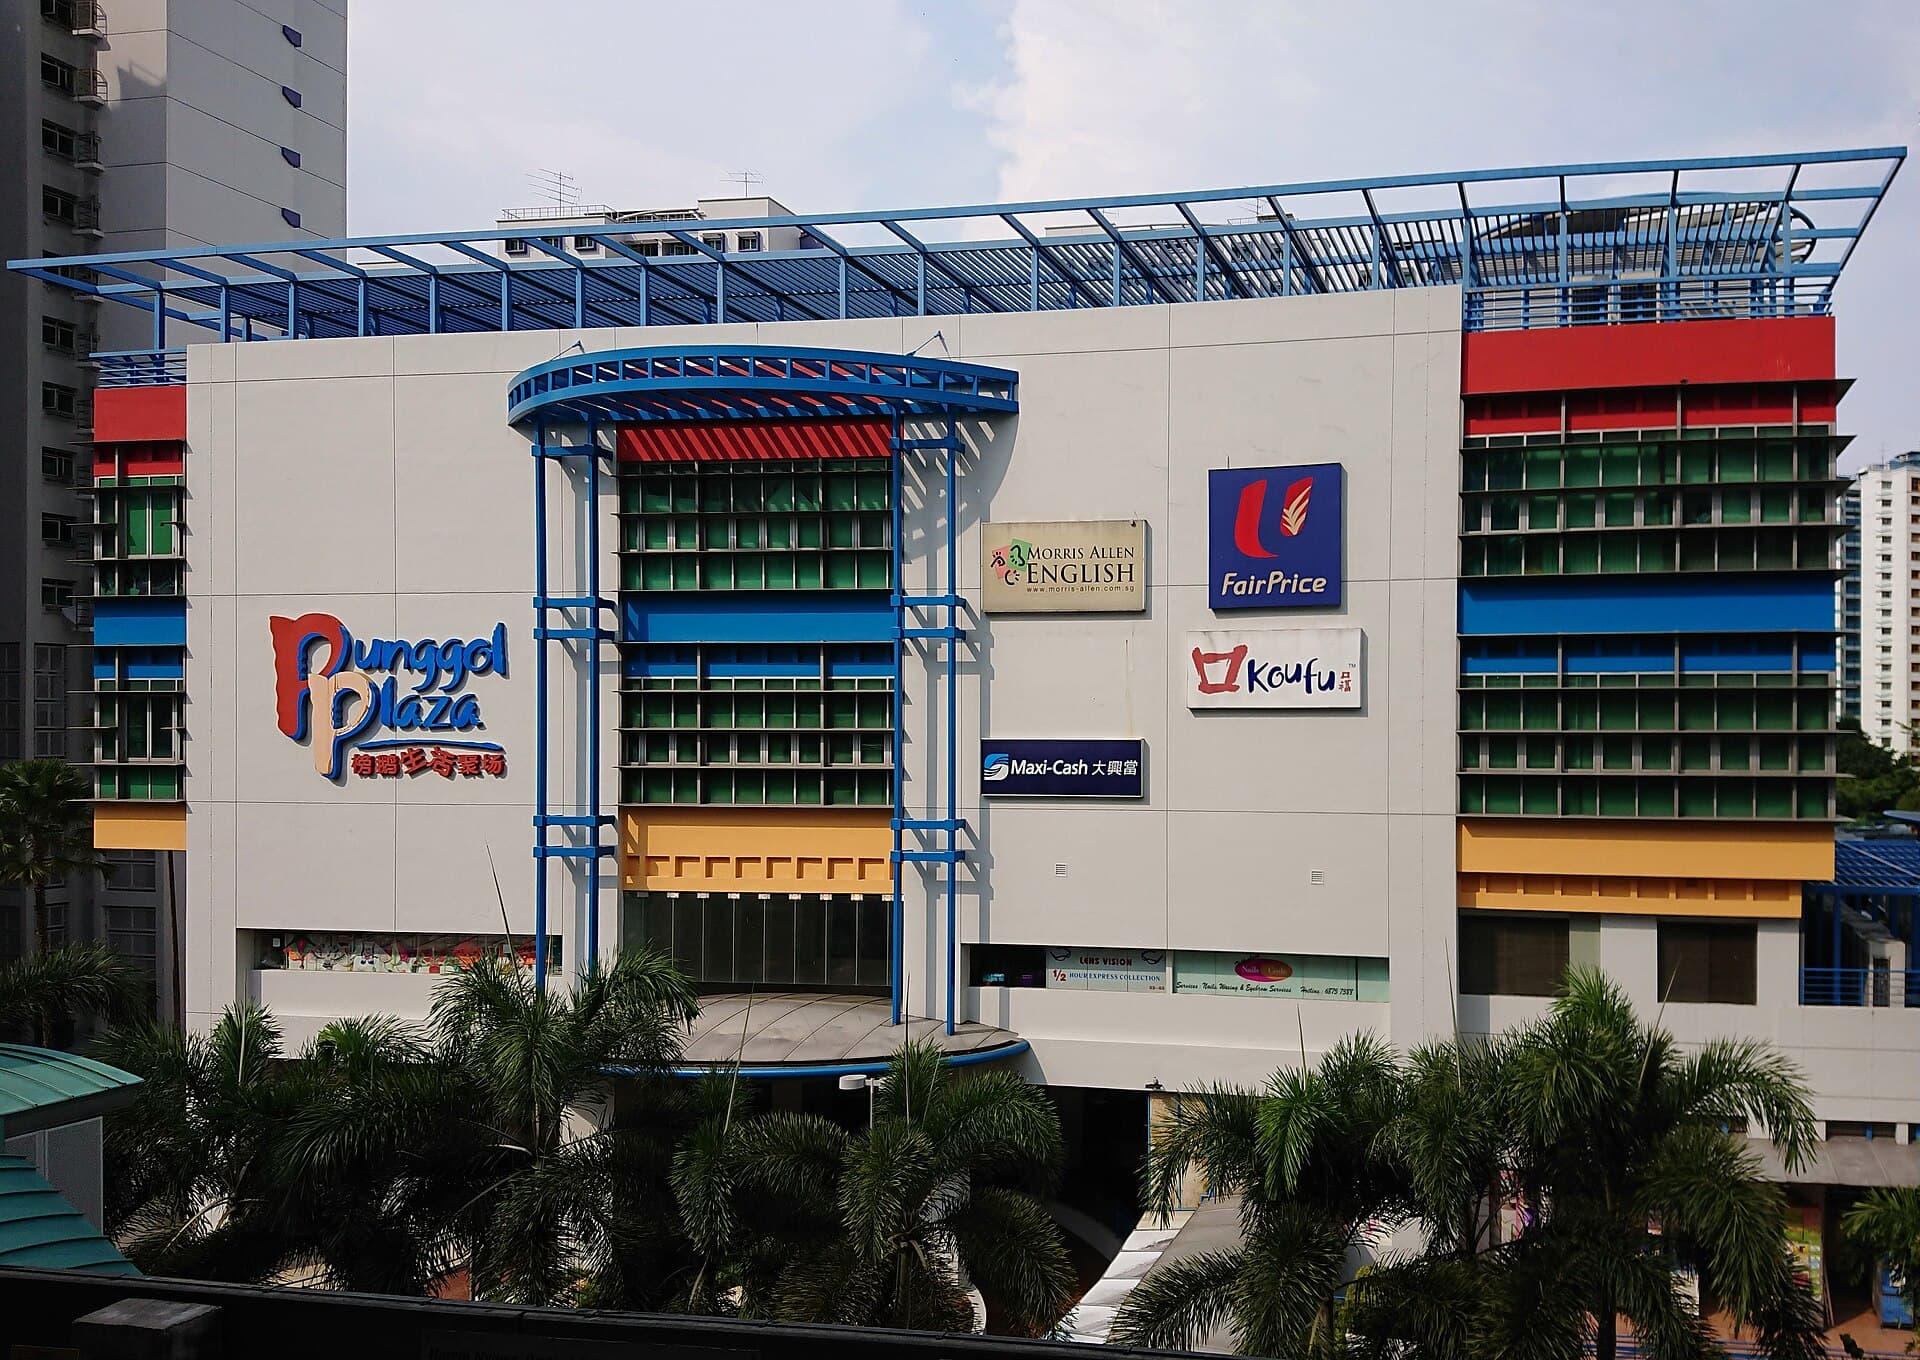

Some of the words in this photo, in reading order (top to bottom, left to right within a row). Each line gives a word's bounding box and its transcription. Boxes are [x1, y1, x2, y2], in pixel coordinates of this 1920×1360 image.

[1027, 547, 1084, 560] MORRIS
[1090, 545, 1134, 559] ALLEN
[1027, 563, 1135, 584] ENGLISH
[1027, 585, 1135, 593] www.morris-allen.com.sg
[1222, 570, 1327, 595] FairPrice
[269, 613, 507, 742] Punggol
[1247, 658, 1336, 694] Koufu
[1010, 759, 1088, 775] Maxi-Cash
[1091, 760, 1138, 776] 大興當
[1103, 957, 1133, 966] VISION
[1053, 968, 1067, 982] 1/2
[1120, 974, 1160, 982] COLLECTION
